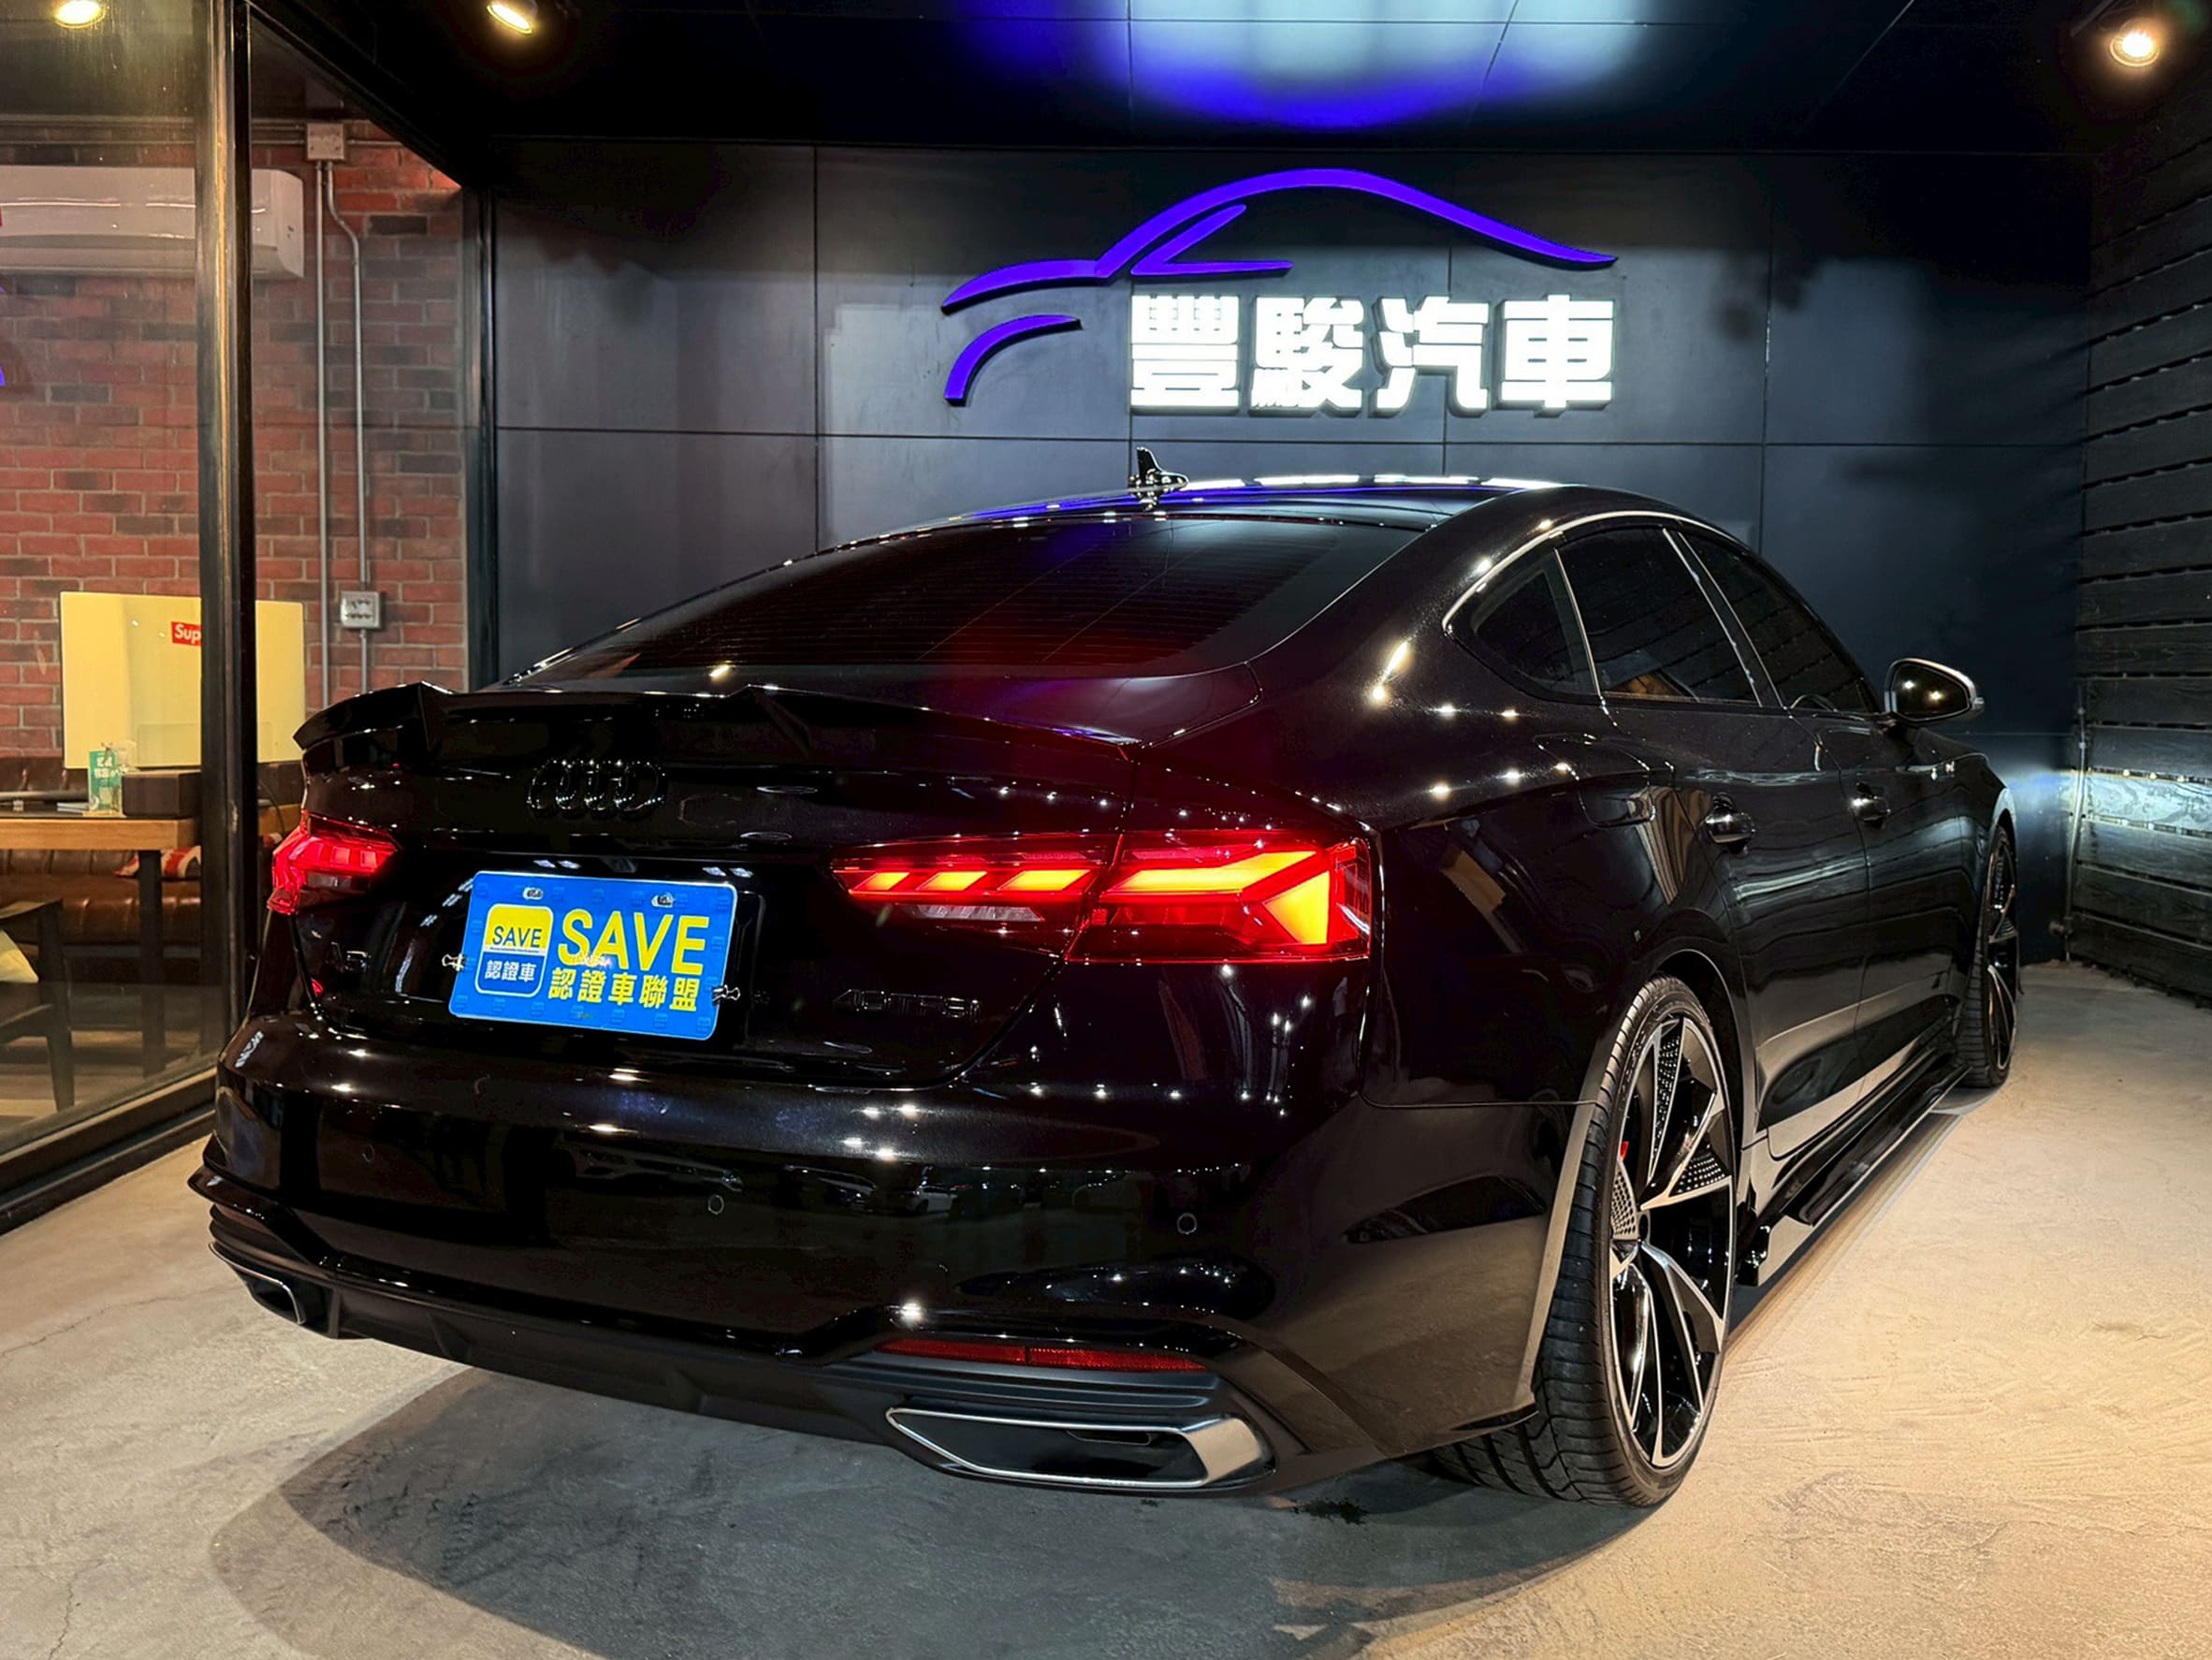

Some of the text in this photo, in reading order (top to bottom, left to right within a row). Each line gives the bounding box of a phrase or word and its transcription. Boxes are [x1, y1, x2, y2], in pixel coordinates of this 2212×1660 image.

[1129, 294, 1615, 412] 豐駿汽車
[491, 925, 543, 949] SAVE
[558, 909, 710, 975] SAVE
[484, 959, 537, 983] 認證車
[547, 967, 701, 1012] 認證車聯盟
